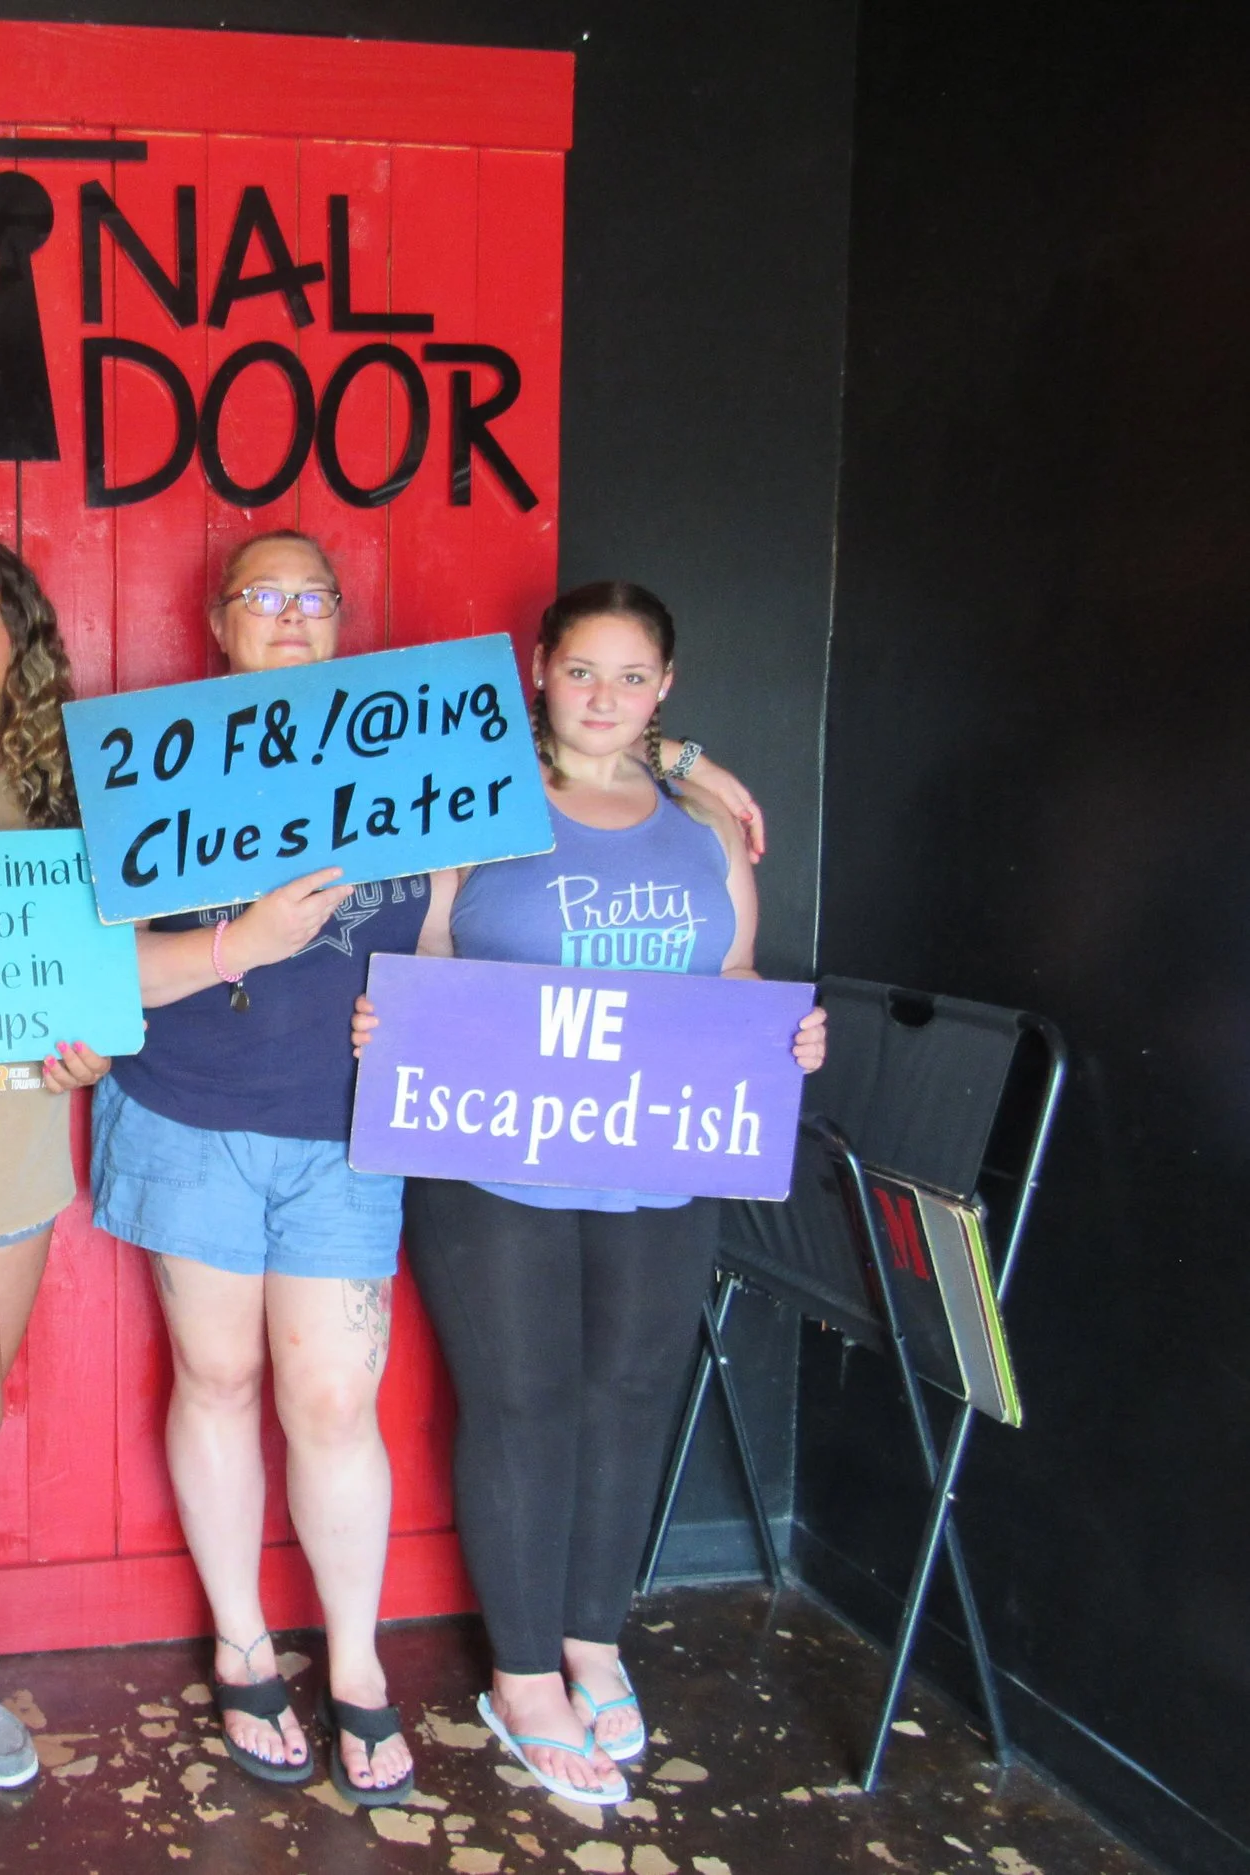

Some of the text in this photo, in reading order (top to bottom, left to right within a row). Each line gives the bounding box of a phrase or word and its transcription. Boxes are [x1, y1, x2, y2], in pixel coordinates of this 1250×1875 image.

[83, 337, 540, 513] DOOR
[100, 718, 196, 790] 20
[121, 774, 513, 888] Clues Later
[546, 875, 707, 944] Pretty
[31, 954, 64, 988] in
[567, 932, 690, 969] TOUGH
[539, 985, 628, 1062] WE
[390, 1066, 762, 1166] Escaped-ish
